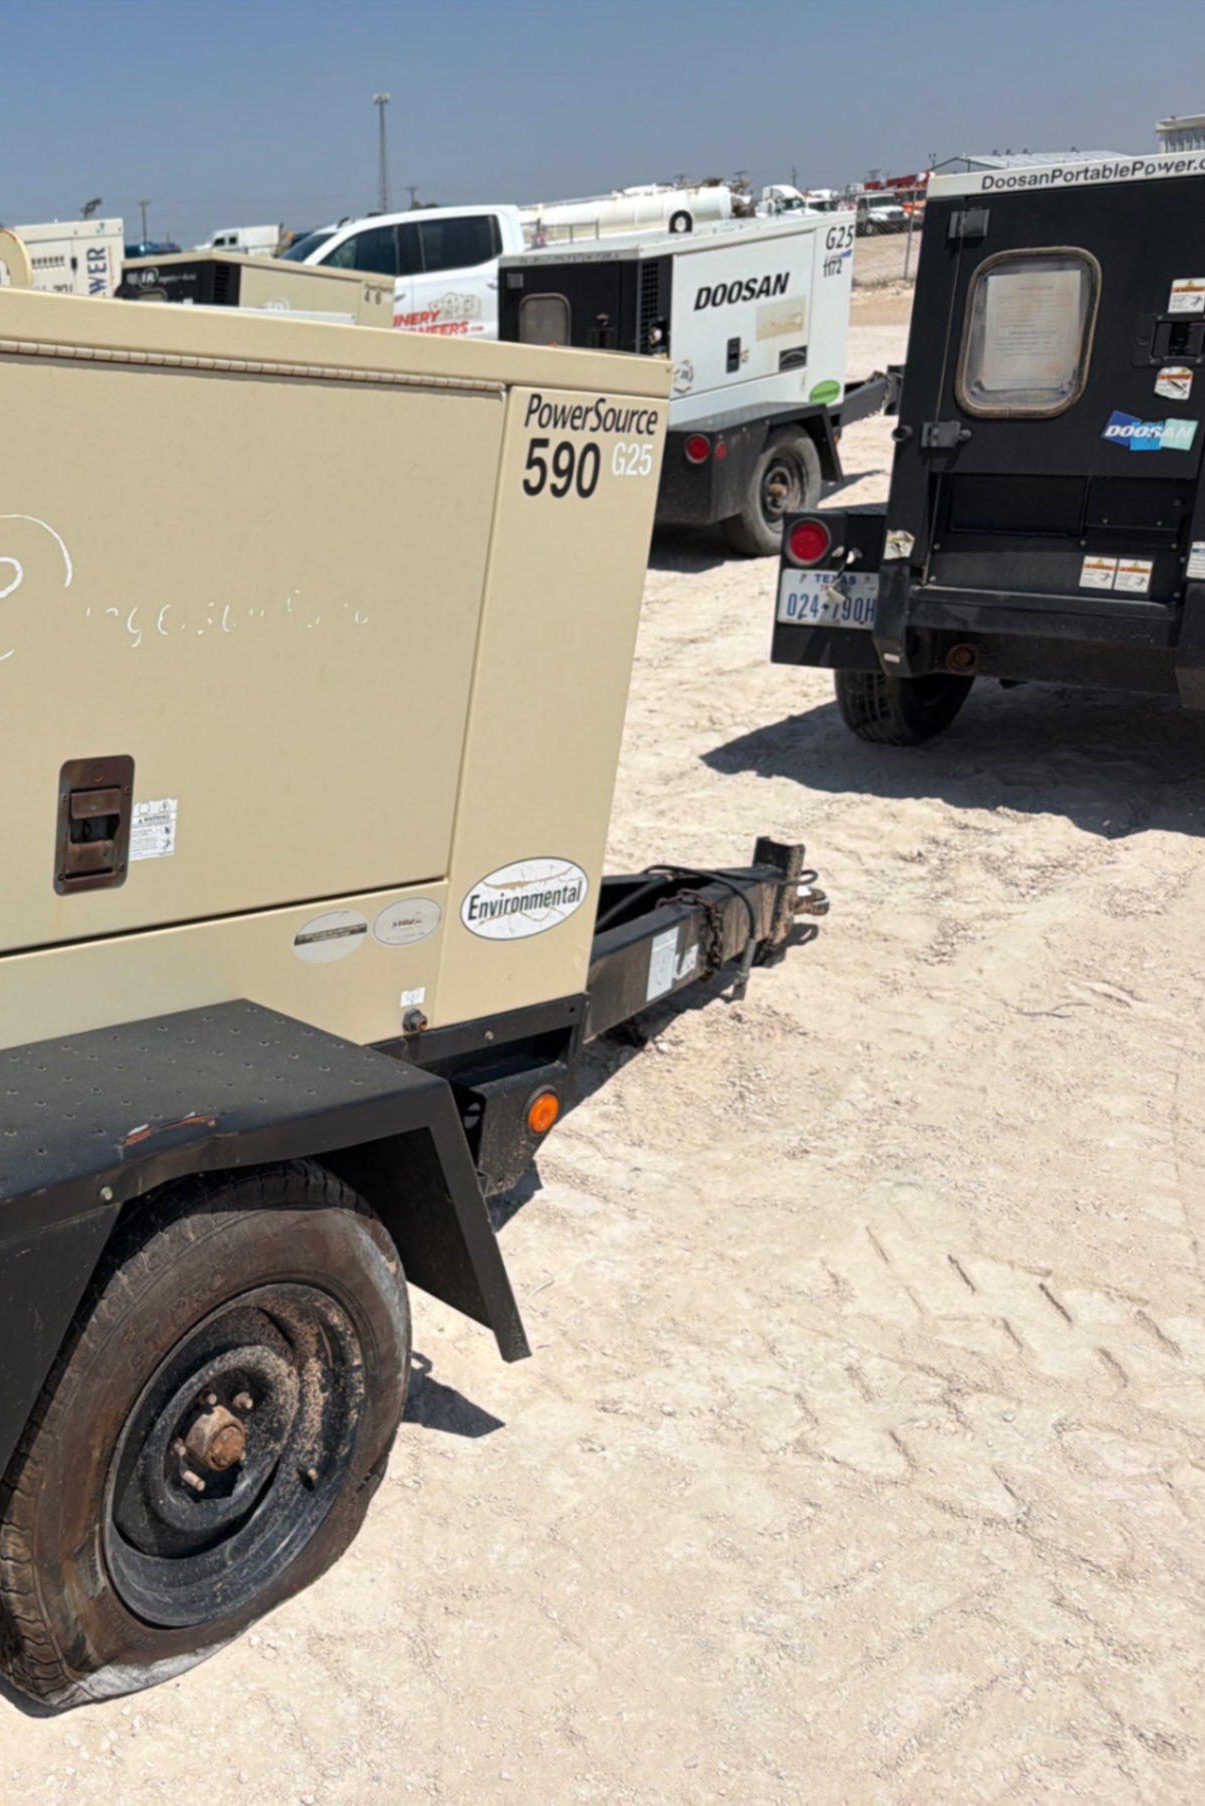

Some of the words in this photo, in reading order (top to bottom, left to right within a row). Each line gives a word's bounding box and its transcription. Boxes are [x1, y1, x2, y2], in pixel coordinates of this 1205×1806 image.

[825, 225, 854, 250] G25
[694, 272, 790, 311] DOOSAN
[524, 393, 659, 435] PowerSource
[1104, 424, 1193, 438] DOOSAN
[522, 437, 601, 499] 590
[611, 442, 654, 476] G25
[467, 879, 583, 921] Environmental
